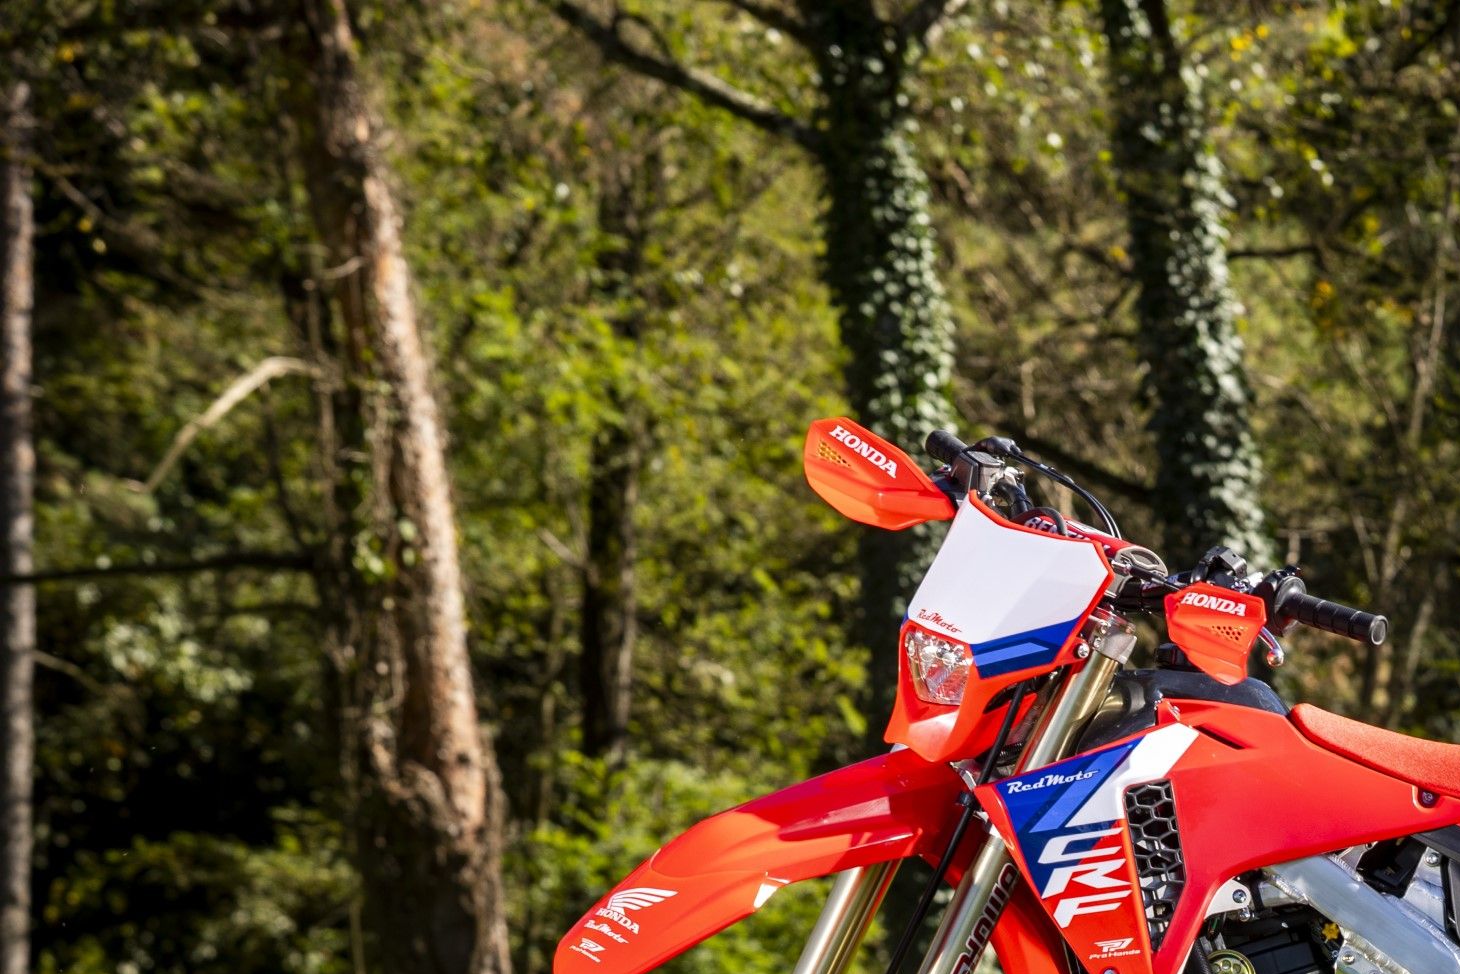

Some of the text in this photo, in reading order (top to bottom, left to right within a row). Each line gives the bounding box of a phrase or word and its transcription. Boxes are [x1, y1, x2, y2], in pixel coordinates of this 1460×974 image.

[829, 425, 898, 479] HONDA
[1181, 592, 1247, 617] HONDA
[1007, 770, 1099, 794] RedMoto
[1037, 827, 1134, 929] CRF
[595, 907, 641, 935] HONDA
